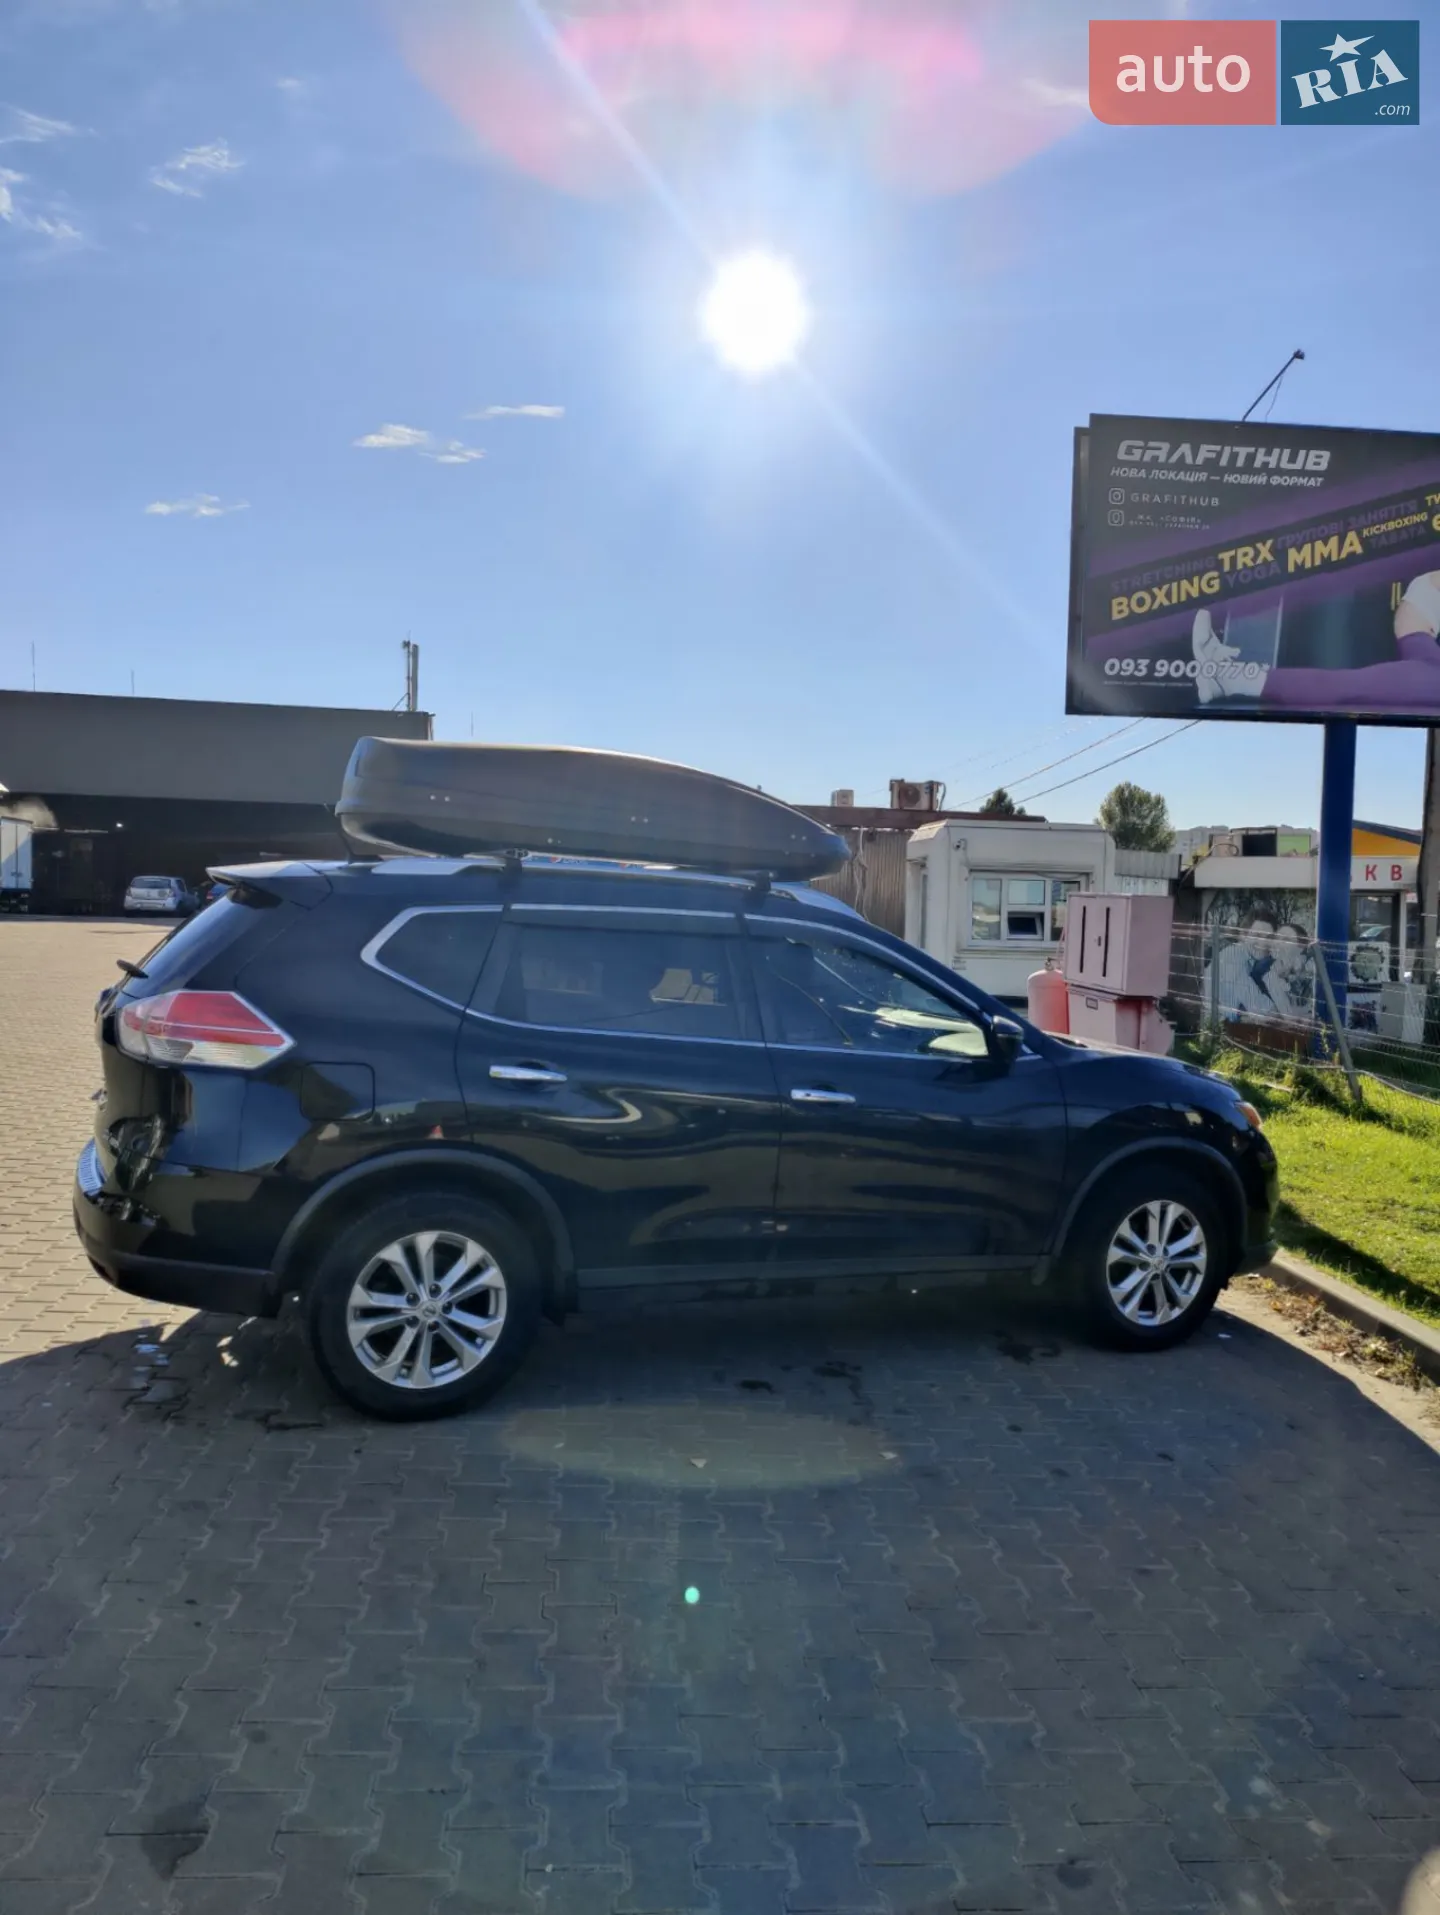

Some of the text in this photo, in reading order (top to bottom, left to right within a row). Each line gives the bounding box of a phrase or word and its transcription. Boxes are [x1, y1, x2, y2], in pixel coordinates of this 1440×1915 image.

[1116, 439, 1331, 471] GRAFITHUB
[1110, 466, 1147, 478] НОВА
[1149, 468, 1208, 483] ЛОКАЦІЯ
[1223, 471, 1268, 485] НОВИЙ
[1270, 475, 1325, 488] ФОРМАТ
[1130, 492, 1220, 507] GRAFITHUB
[1362, 511, 1429, 538] KICKBOXING
[1218, 539, 1275, 573] TRX
[1287, 530, 1363, 573] MMA
[1111, 556, 1217, 594] STRETCHING
[1225, 562, 1282, 588] YOGA
[1111, 571, 1221, 621] BOXING
[1104, 657, 1150, 677] 093
